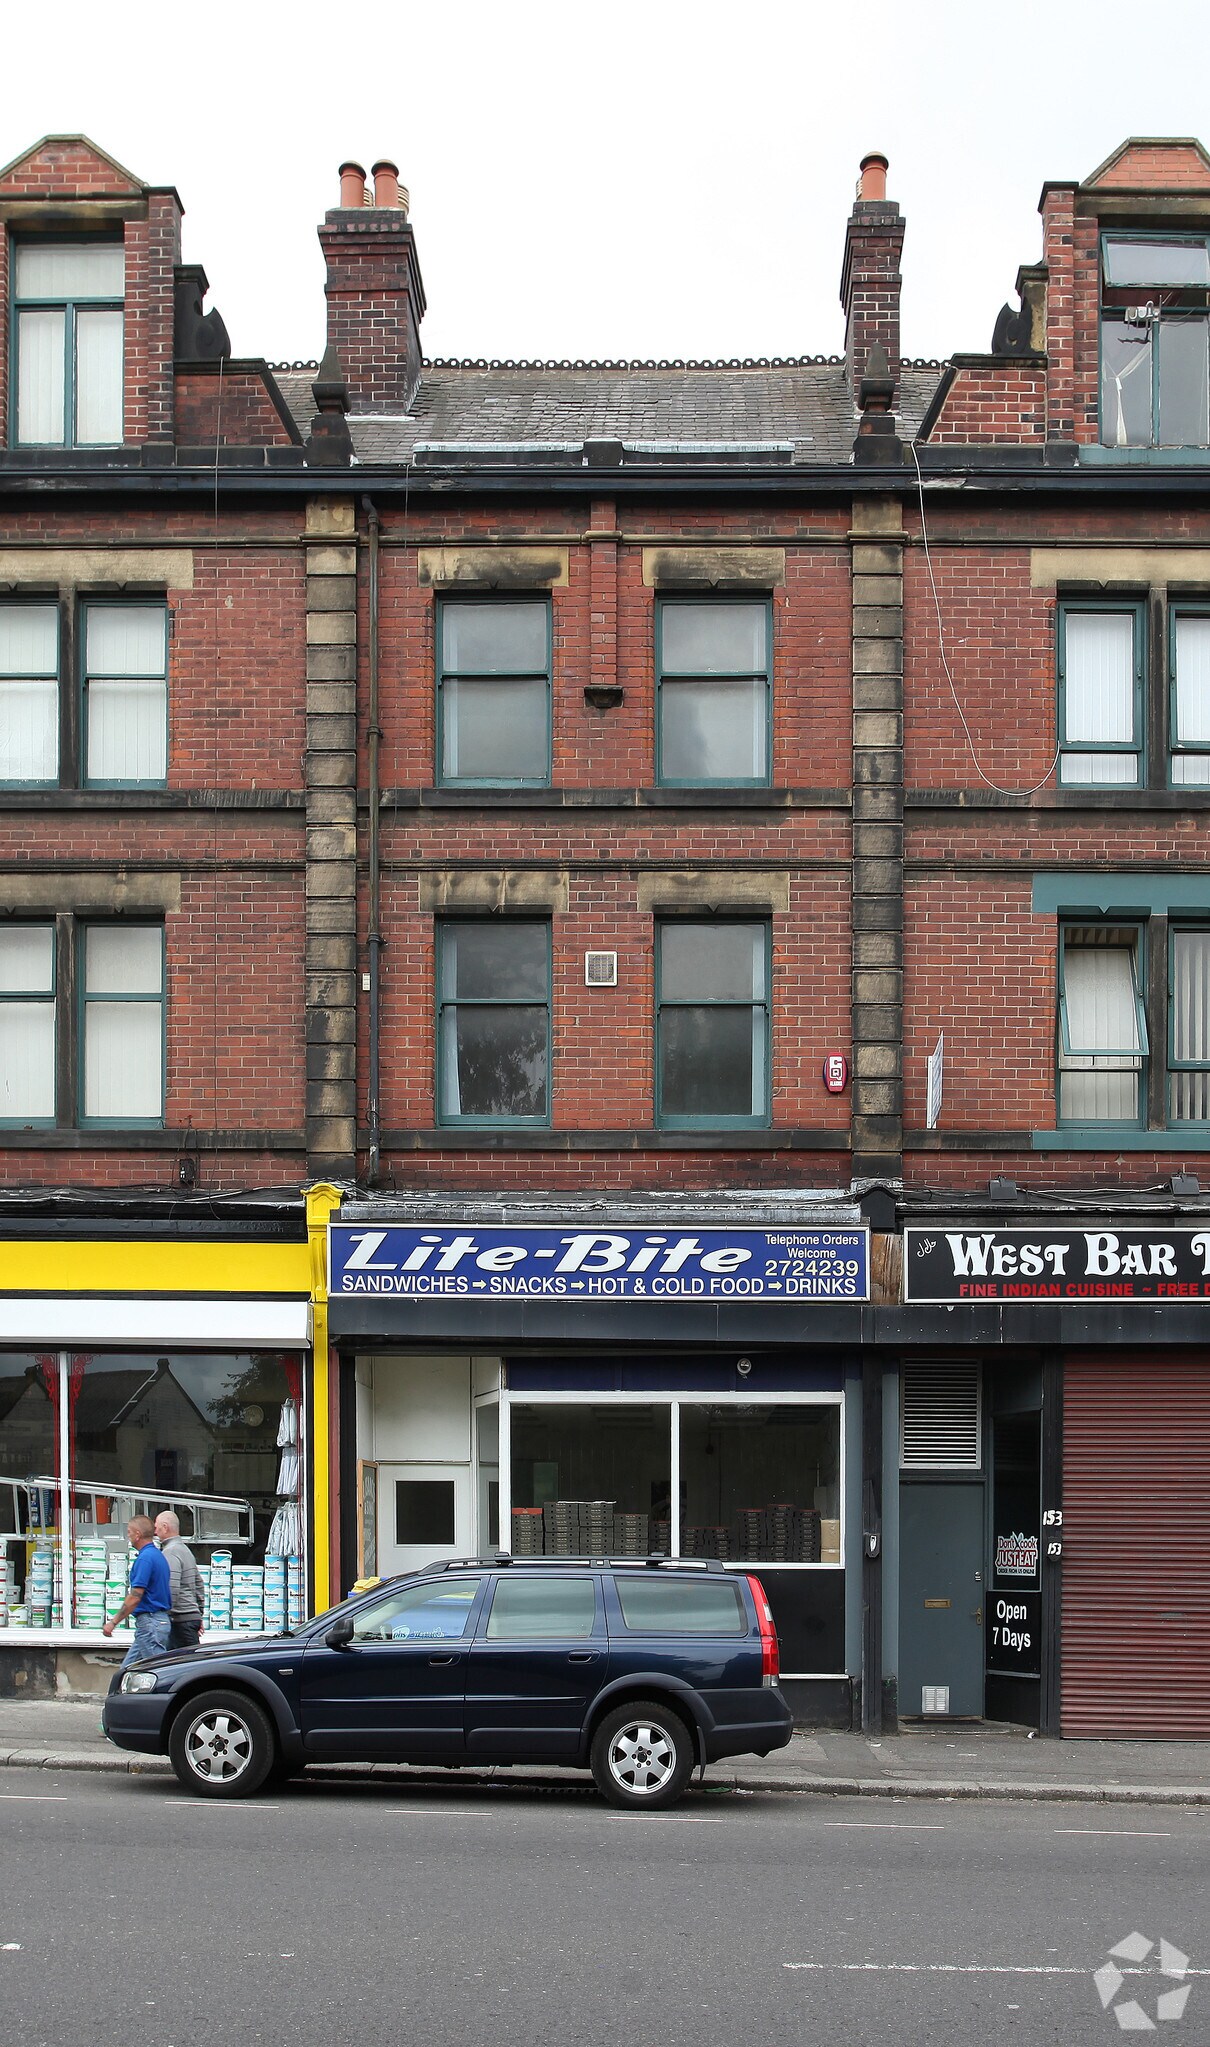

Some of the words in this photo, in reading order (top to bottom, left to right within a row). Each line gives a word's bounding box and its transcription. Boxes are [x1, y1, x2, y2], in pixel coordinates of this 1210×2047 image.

[765, 1234, 819, 1247] Telephone
[822, 1234, 859, 1245] Orders
[342, 1231, 753, 1273] Lite-Bite
[787, 1248, 837, 1259] Welcome
[764, 1260, 859, 1277] 2724239
[341, 1275, 469, 1293] SANDWICHES
[489, 1276, 567, 1294] SNACKS
[588, 1277, 629, 1294] HOT
[633, 1278, 647, 1294] &
[651, 1278, 704, 1294] COLD
[710, 1278, 764, 1294] FOOD
[785, 1278, 857, 1294] DRINKS
[959, 1283, 997, 1297] FINE
[1002, 1283, 1061, 1297] INDIAN
[1065, 1283, 1134, 1297] CUISINE
[1157, 1283, 1198, 1297] FREE
[1042, 1510, 1063, 1526] 153
[1047, 1542, 1062, 1556] 153
[997, 1550, 1017, 1566] JUST
[1019, 1551, 1036, 1566] EAT
[996, 1599, 1027, 1624] Open
[992, 1626, 1000, 1645] 7
[1002, 1627, 1031, 1652] Days
